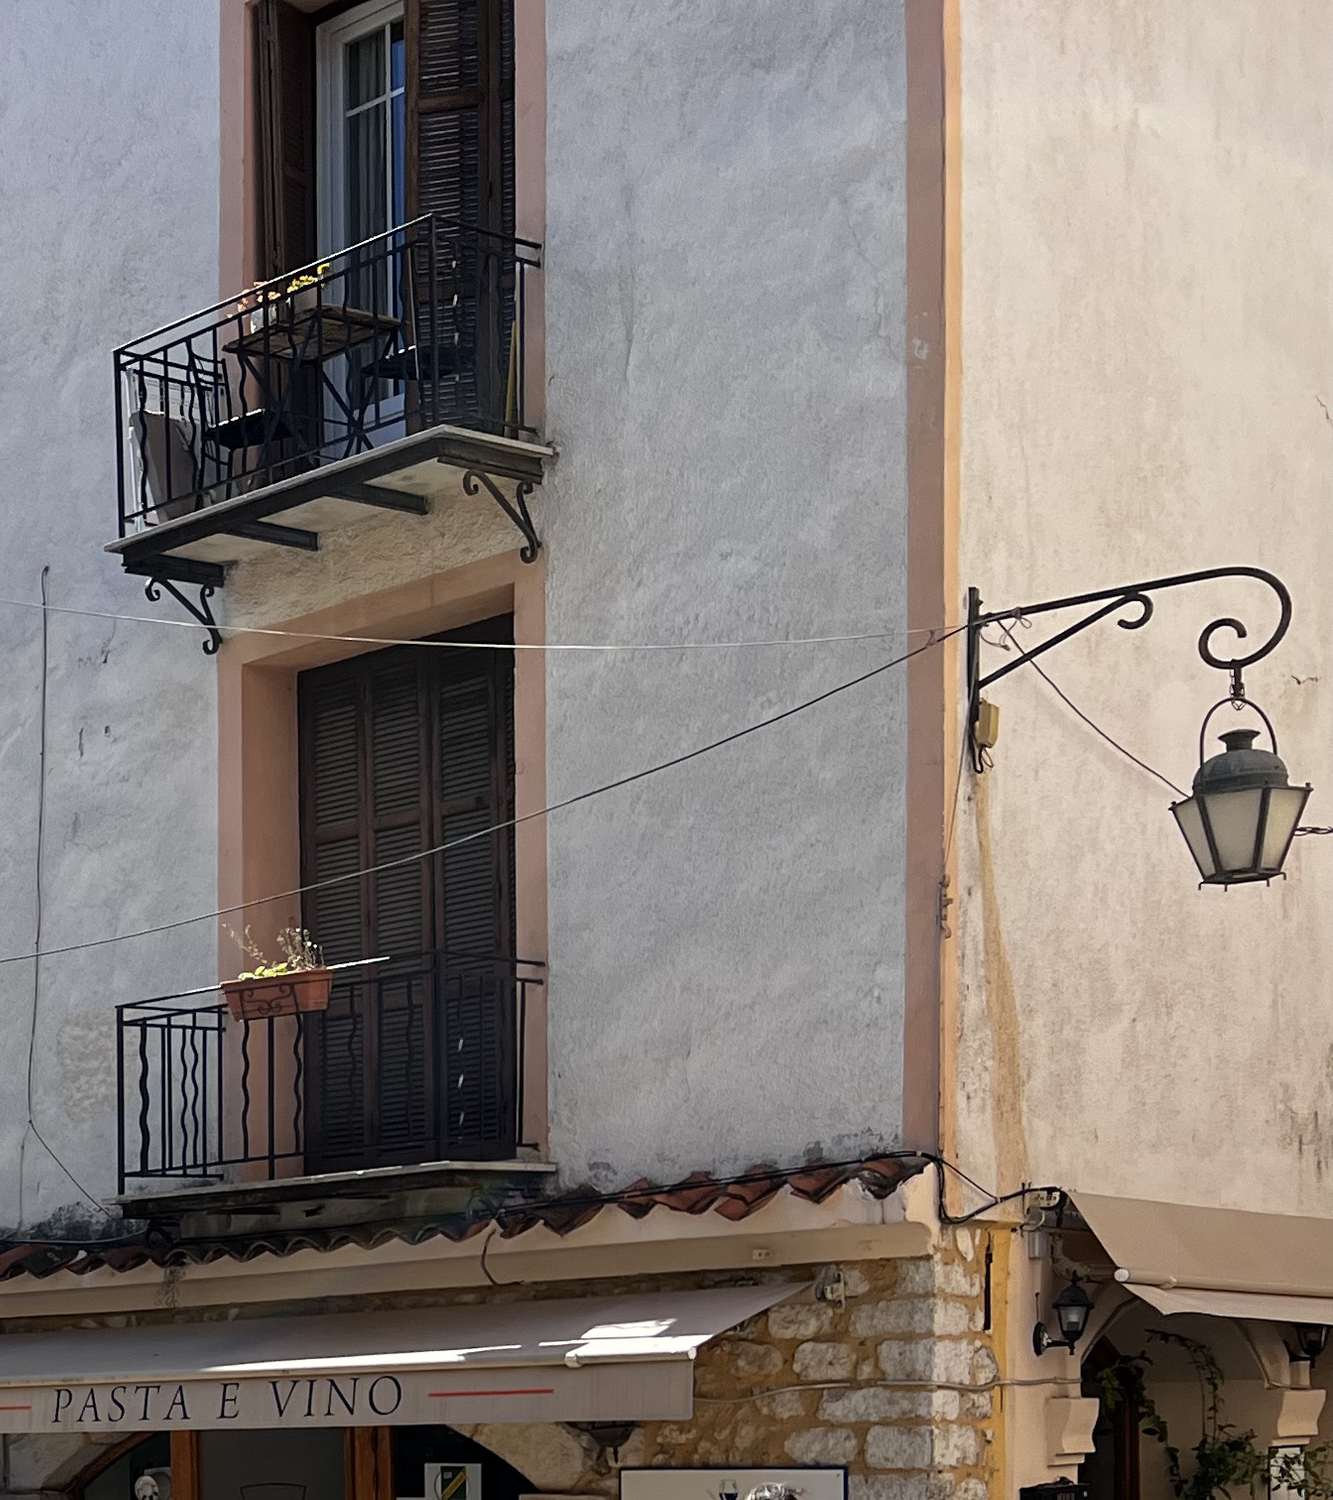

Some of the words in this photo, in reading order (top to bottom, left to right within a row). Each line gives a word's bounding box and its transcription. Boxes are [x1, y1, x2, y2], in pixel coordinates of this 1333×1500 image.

[51, 1385, 191, 1424] PASTA
[216, 1382, 240, 1420] E
[269, 1375, 402, 1418] VINO
